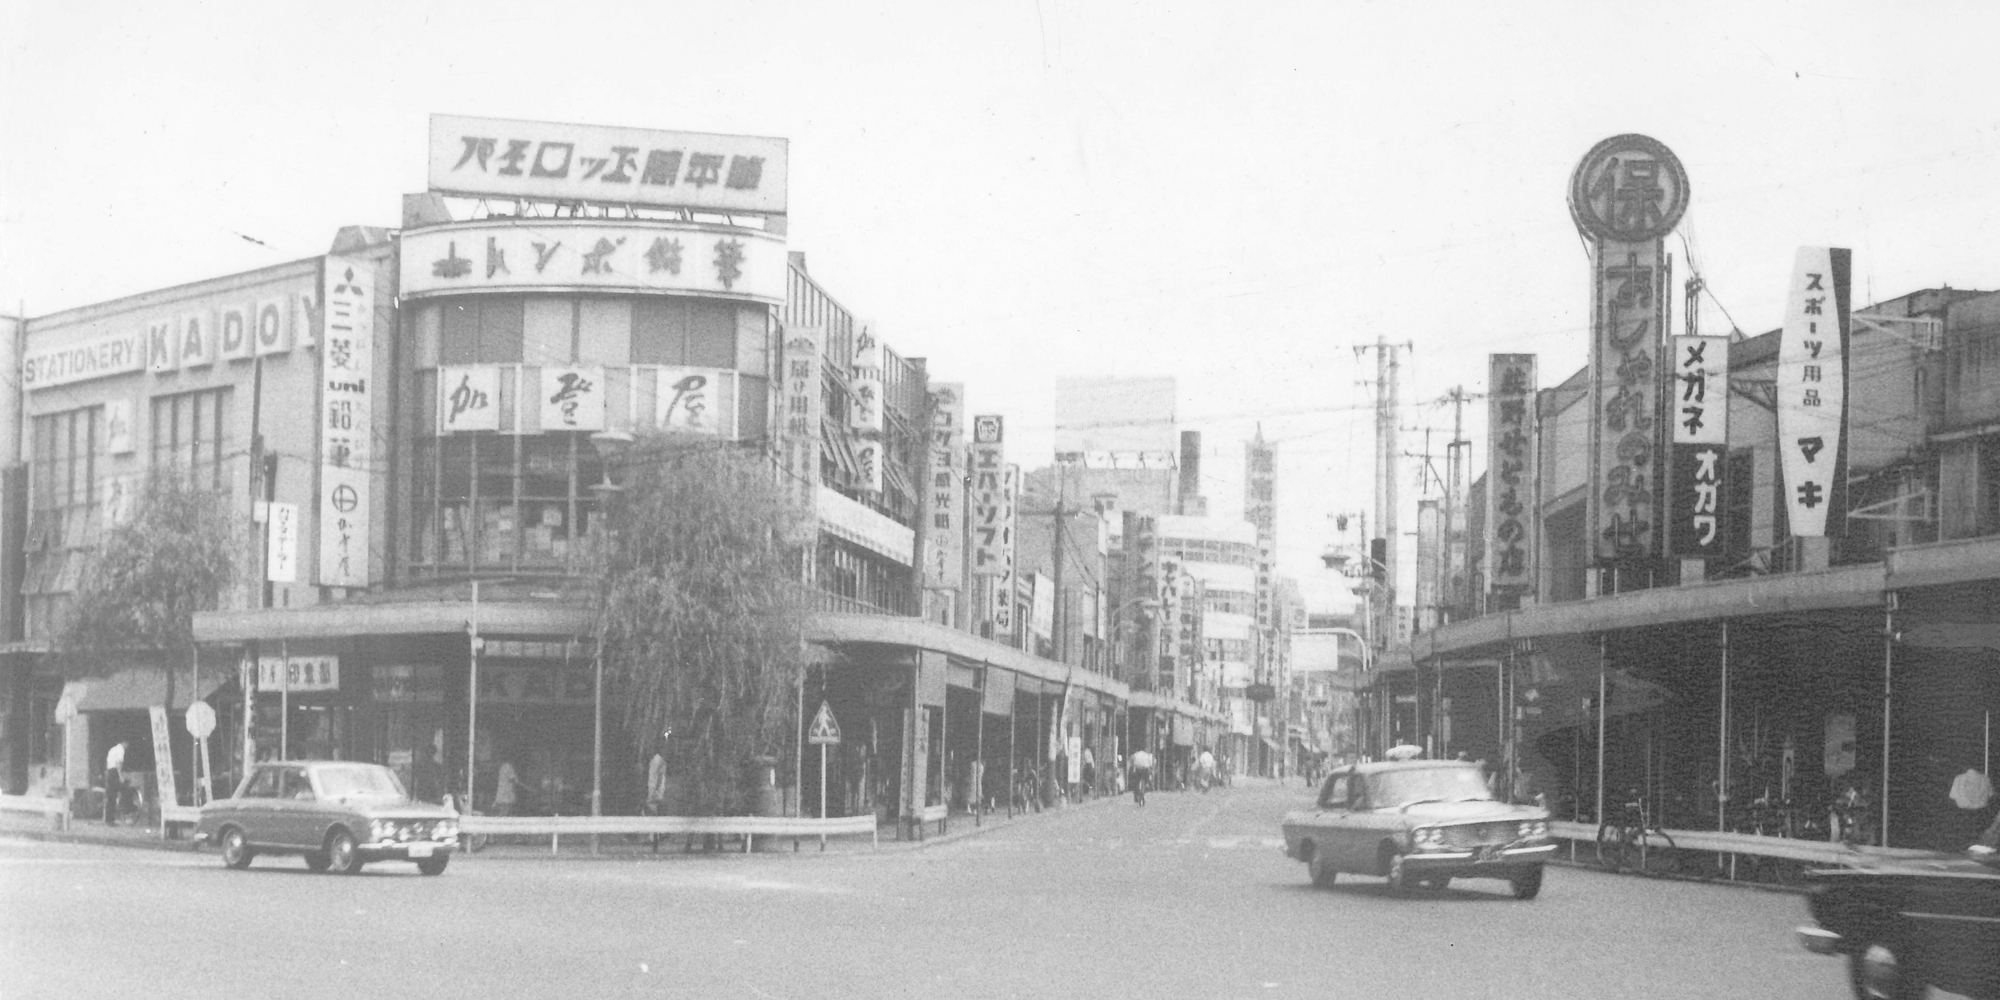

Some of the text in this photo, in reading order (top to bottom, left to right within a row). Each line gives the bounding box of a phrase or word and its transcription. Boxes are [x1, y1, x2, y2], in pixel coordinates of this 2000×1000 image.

[1590, 156, 1664, 231] 保
[25, 337, 136, 389] STATIONERY
[329, 379, 365, 394] uni
[1602, 253, 1654, 557] おしゃれのみせ
[1797, 271, 1826, 509] スポーツ用品 マキ
[1682, 341, 1722, 546] メガネ オガワ
